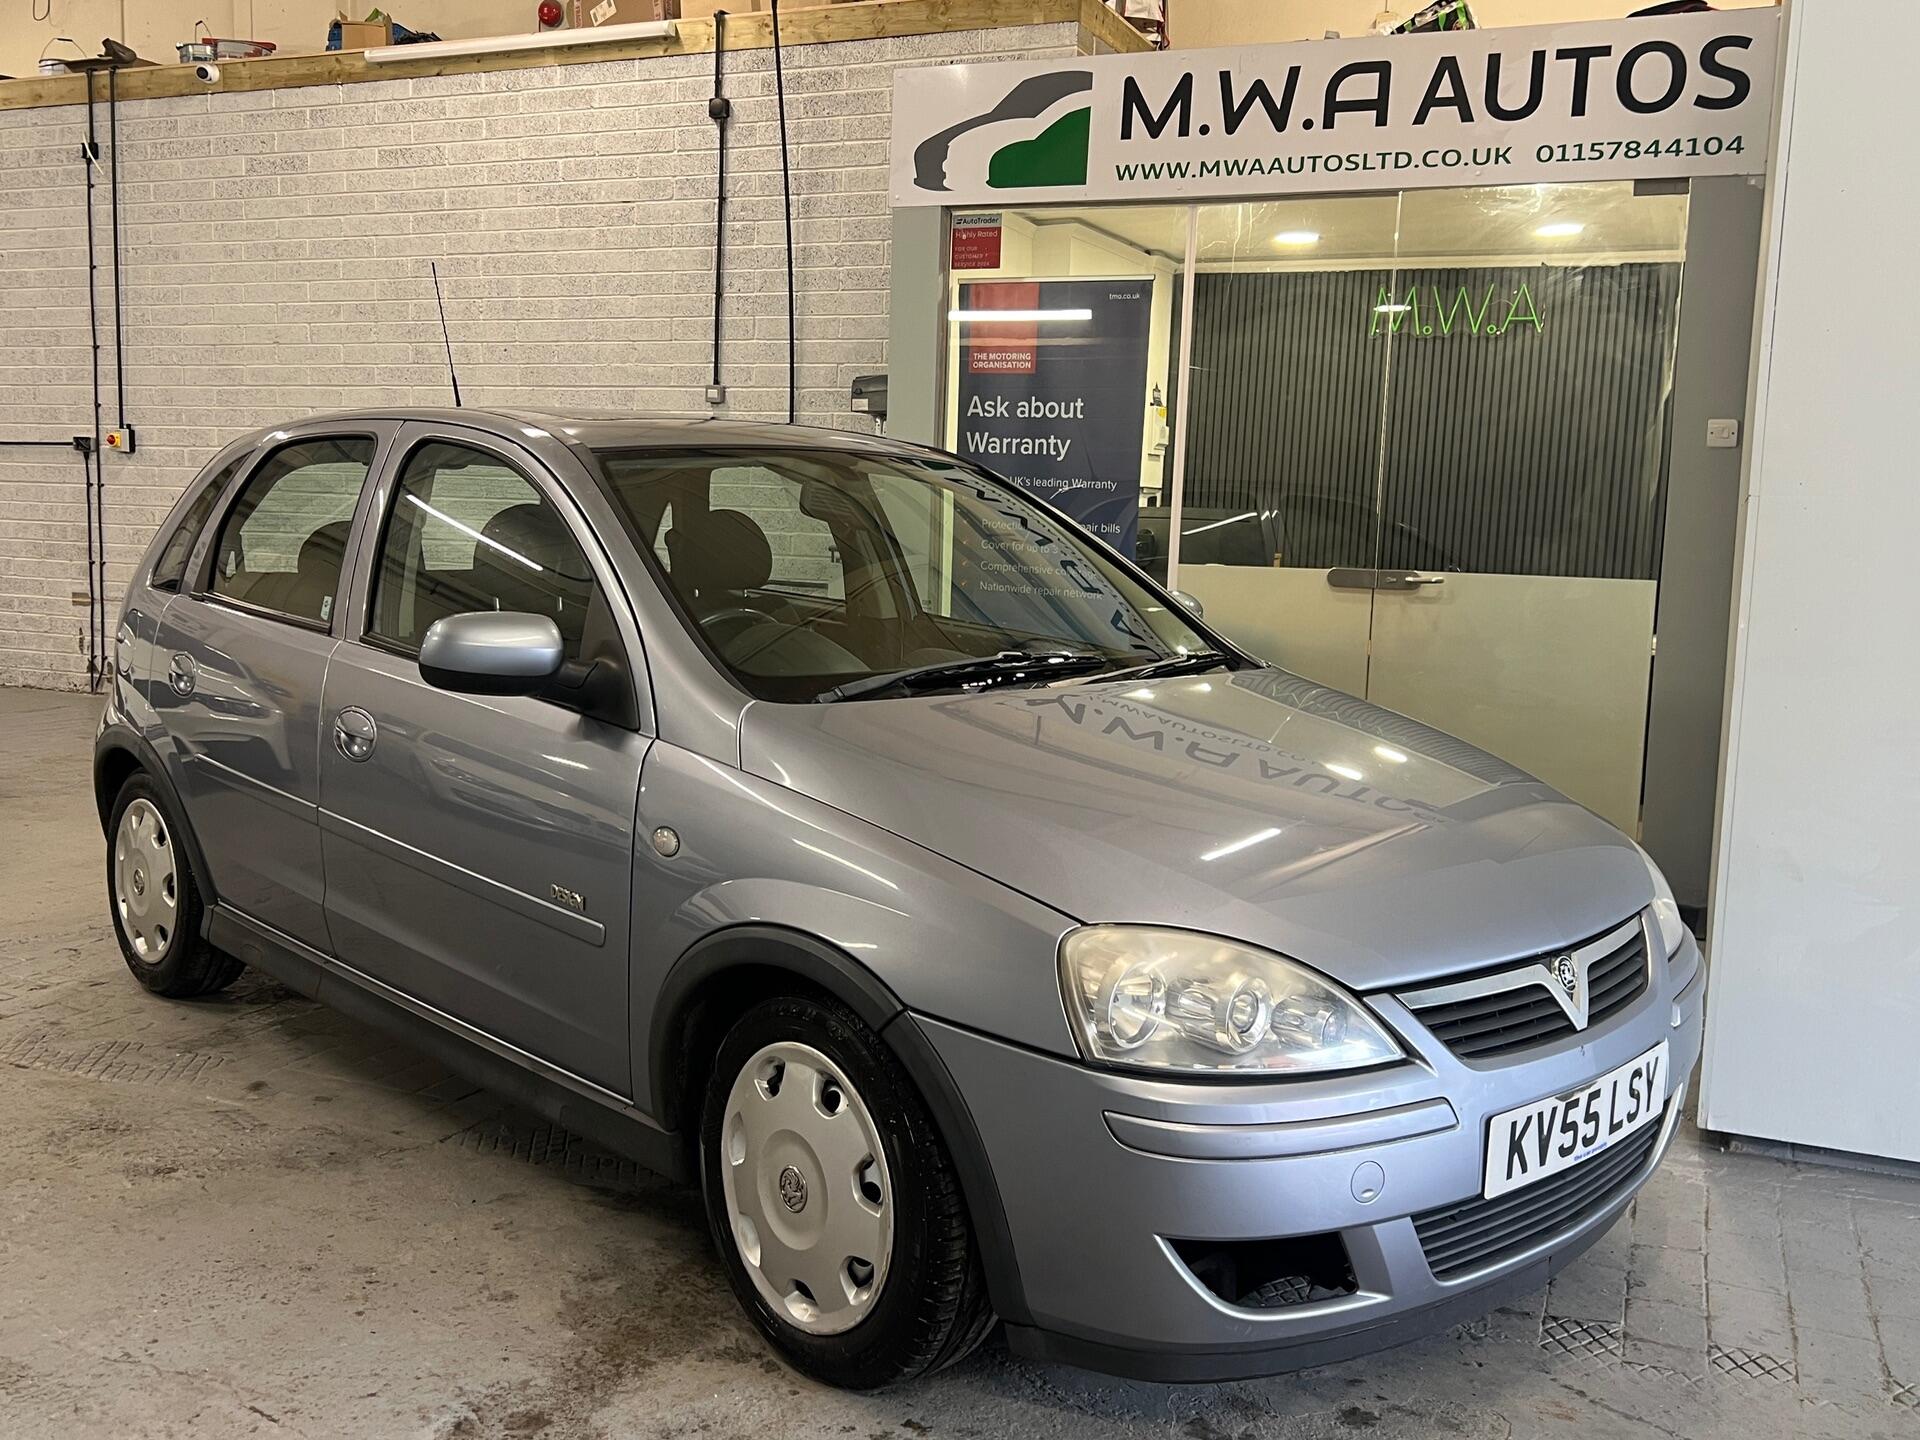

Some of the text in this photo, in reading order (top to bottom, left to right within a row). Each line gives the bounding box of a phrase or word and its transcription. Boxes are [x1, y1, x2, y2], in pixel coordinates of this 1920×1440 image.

[1120, 35, 1753, 140] M.W.A AUTOS
[1115, 135, 1745, 182] WWW.MWAAUTOSLTD.CO.UK 01157844104
[978, 230, 998, 238] Rated
[1109, 292, 1140, 300] tmo.co.uk
[1371, 283, 1543, 336] M.W.A
[973, 353, 1031, 361] THE MOTORING
[972, 361, 1031, 370] ORGANISATION
[967, 395, 1084, 419] Ask about
[966, 431, 1072, 462] Warranty
[1033, 477, 1069, 489] leading
[1072, 478, 1118, 493] Warranty
[1100, 523, 1121, 534] bills
[980, 538, 1010, 551] Cover
[1011, 541, 1026, 551] for
[1040, 544, 1050, 553] to
[980, 560, 1054, 575] Comprehensive
[979, 581, 1032, 594] Nationwide
[1033, 586, 1061, 598] repair
[1506, 1056, 1659, 1181] KV55 LSY
